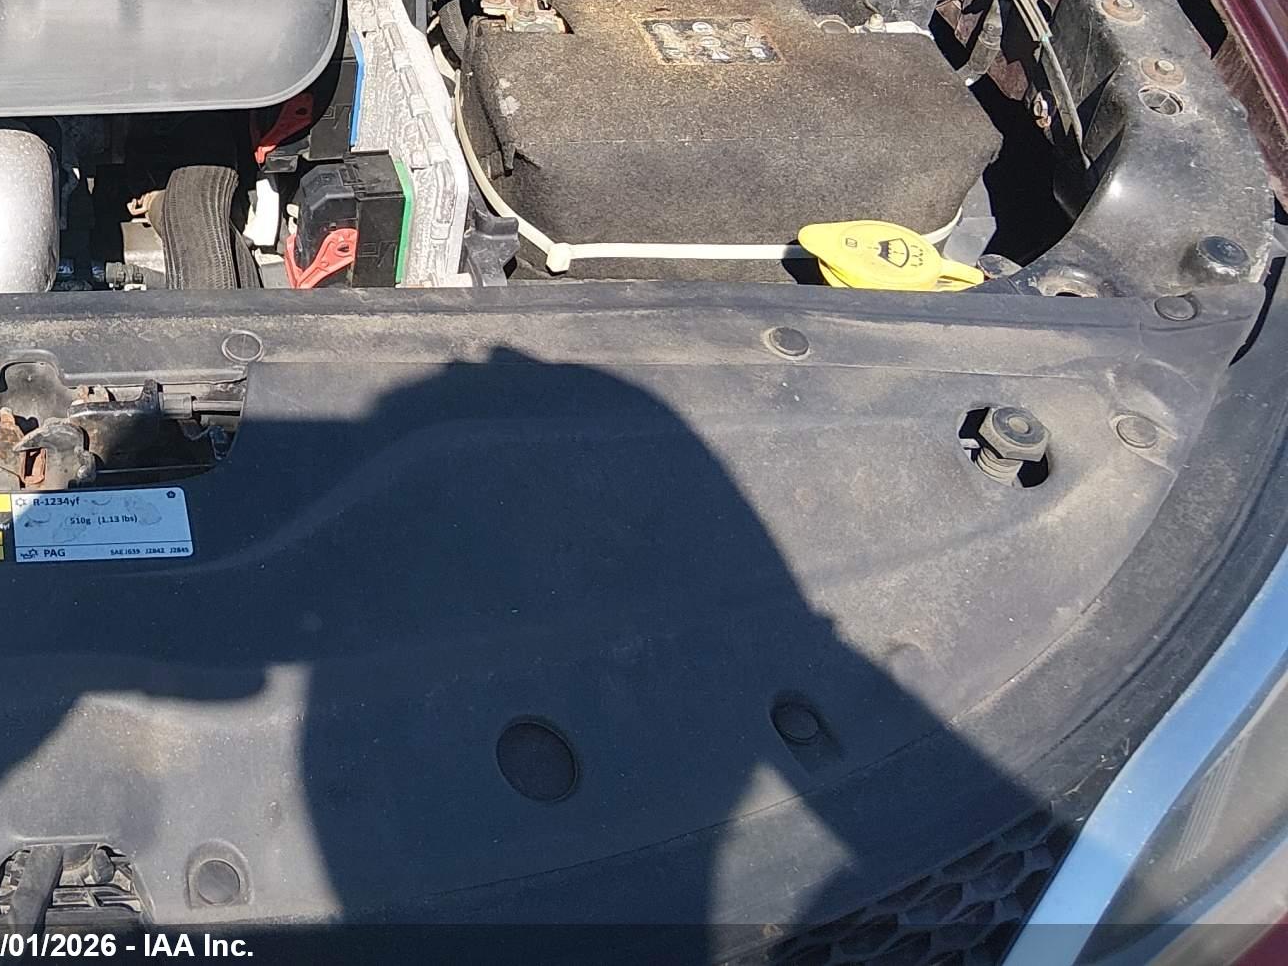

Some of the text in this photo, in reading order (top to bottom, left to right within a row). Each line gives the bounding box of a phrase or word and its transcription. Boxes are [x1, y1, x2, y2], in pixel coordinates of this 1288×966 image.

[32, 496, 80, 508] R-1234yf
[69, 514, 138, 526] 510g (1.13 lbs)
[43, 548, 66, 558] PAG
